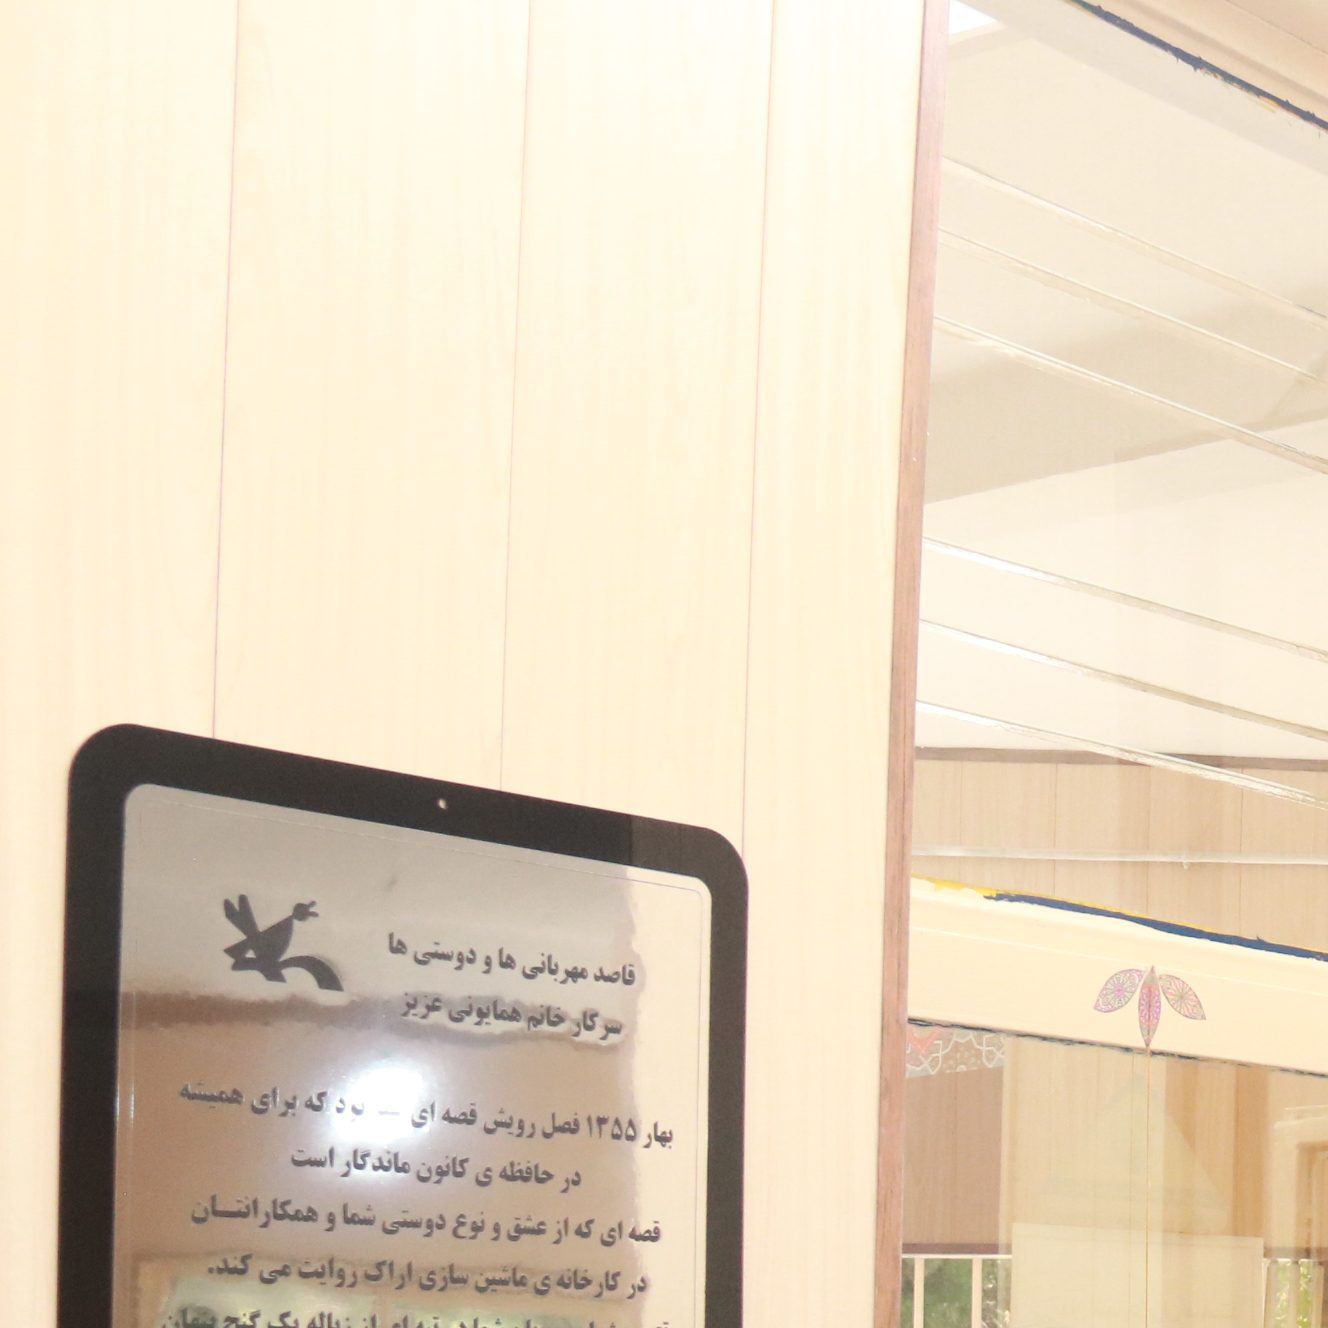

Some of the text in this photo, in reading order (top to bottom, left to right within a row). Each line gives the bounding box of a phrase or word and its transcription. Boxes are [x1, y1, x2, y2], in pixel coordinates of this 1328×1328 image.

[388, 932, 636, 986] قاصد مهربانی ها و دوستی ها
[401, 992, 442, 1019] عزیز
[448, 996, 522, 1026] همایونی
[527, 1005, 566, 1032] خانم
[180, 1080, 673, 1149] بهار ۱۳۵۵ فصل رویش قصه ای که برای همیشه
[291, 1146, 582, 1193] در حافظه کانون ماندگار است
[342, 1203, 376, 1226] شما
[382, 1209, 446, 1237] دوستی
[452, 1212, 485, 1240] نوع
[507, 1215, 547, 1242] عشق
[552, 1217, 569, 1244] از
[574, 1219, 595, 1239] که
[600, 1221, 623, 1247] ای
[628, 1221, 661, 1242] قصه
[208, 1253, 647, 1299] در کارخانه ماشین سازی اراک روایت می کند.
